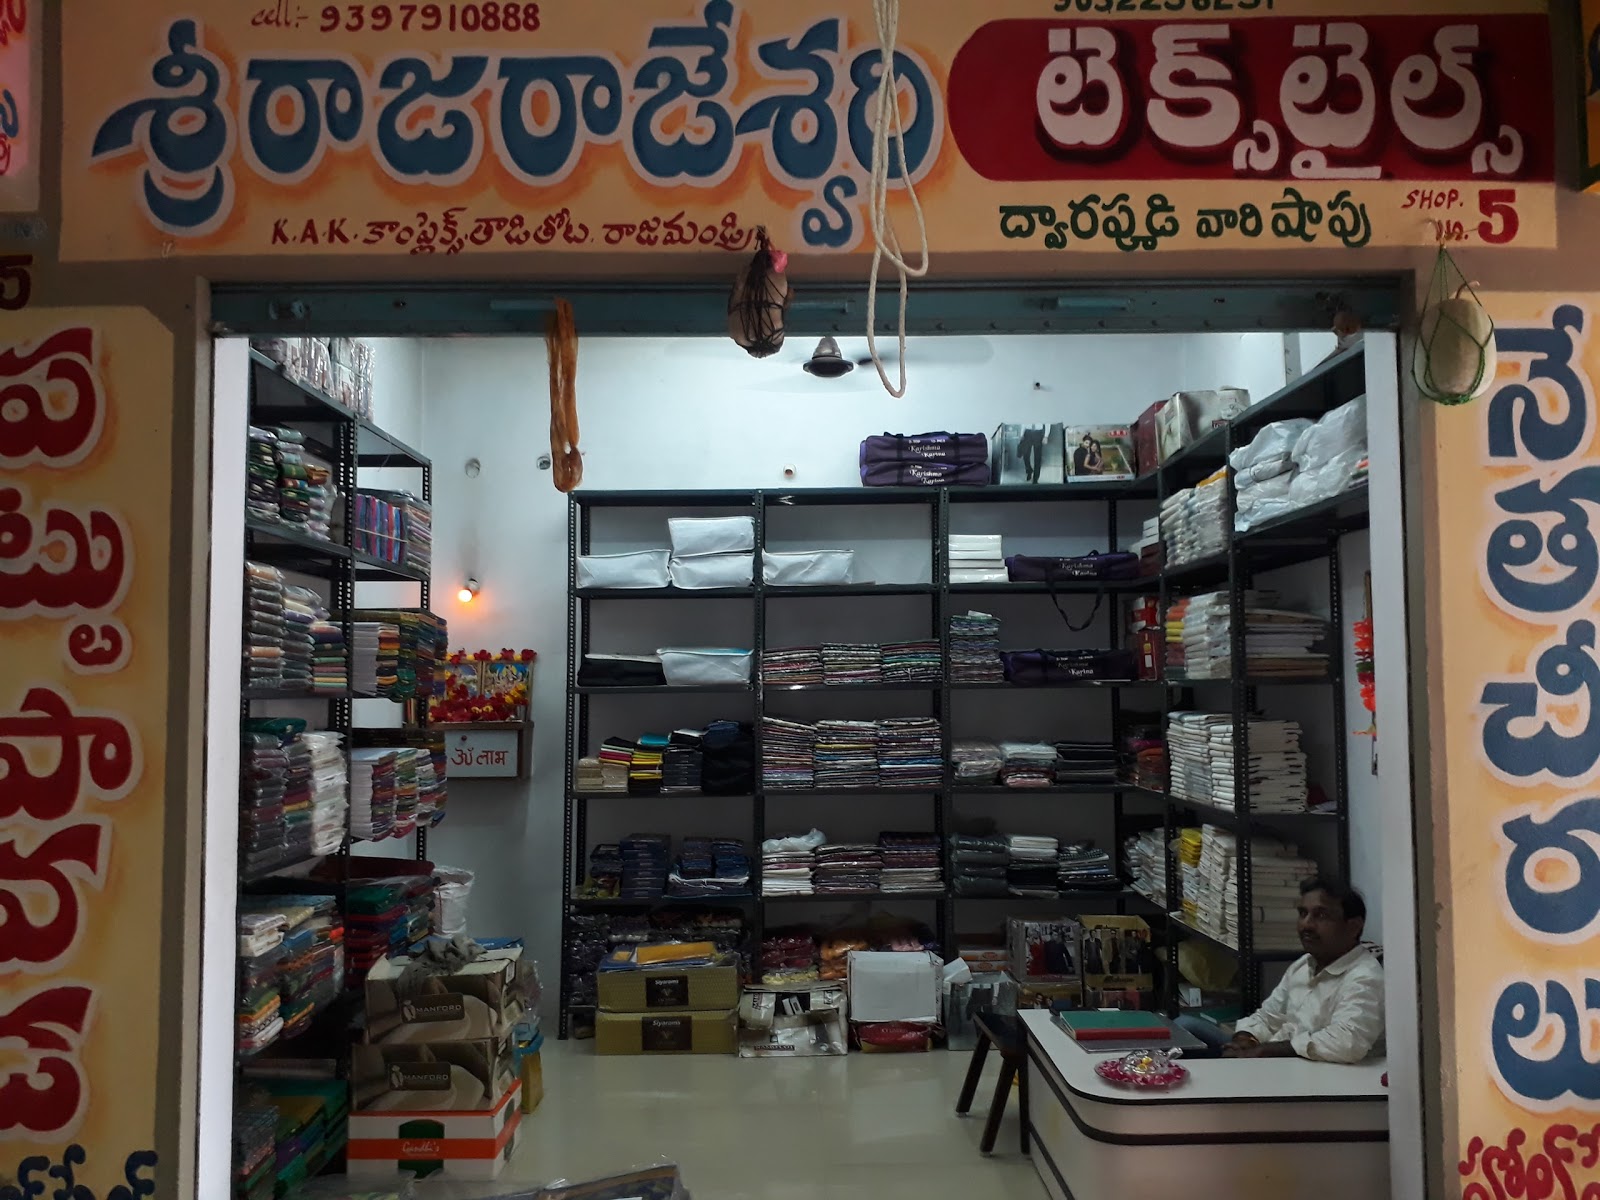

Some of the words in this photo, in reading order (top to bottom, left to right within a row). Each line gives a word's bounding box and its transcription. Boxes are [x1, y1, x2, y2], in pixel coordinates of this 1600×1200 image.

[320, 2, 540, 32] 9397910888
[1196, 203, 1263, 237] వారి
[1271, 187, 1371, 248] షాపు
[1401, 189, 1463, 209] SHOP.
[1478, 189, 1519, 244] 5
